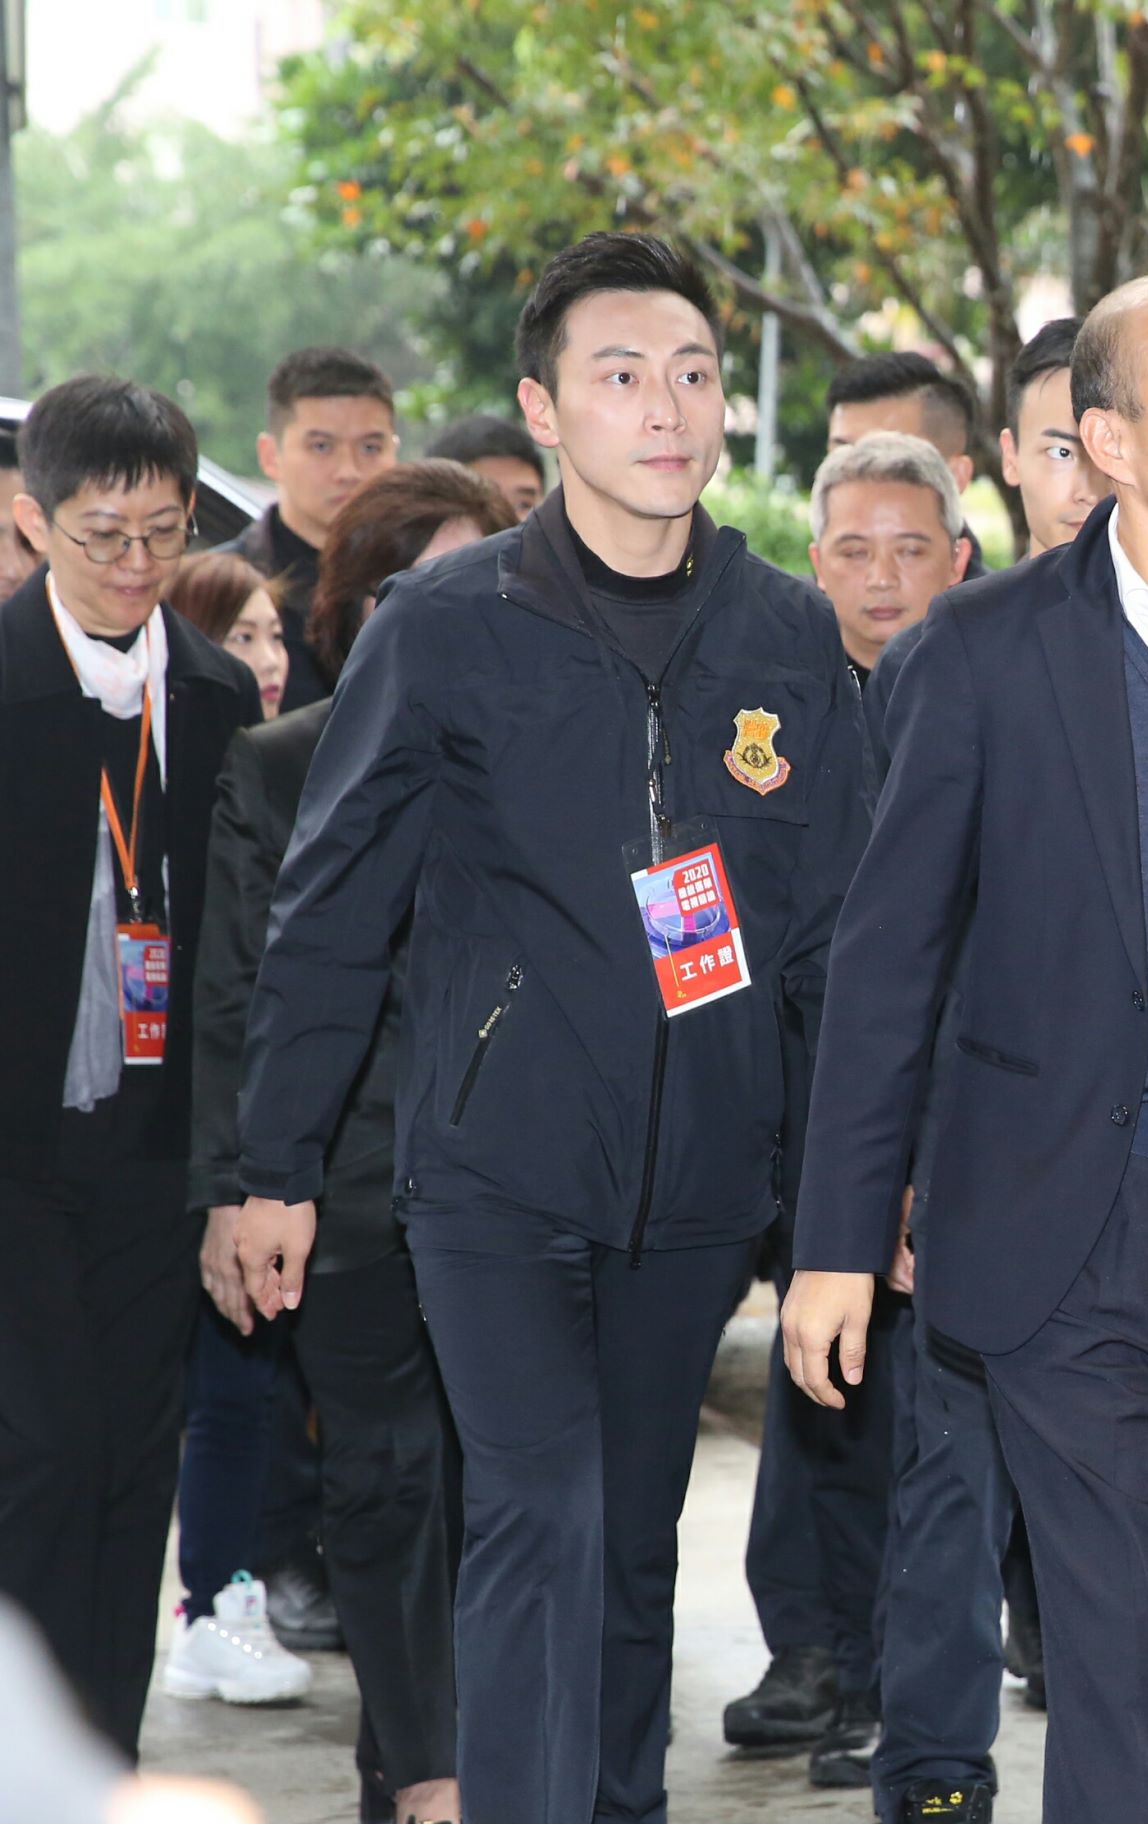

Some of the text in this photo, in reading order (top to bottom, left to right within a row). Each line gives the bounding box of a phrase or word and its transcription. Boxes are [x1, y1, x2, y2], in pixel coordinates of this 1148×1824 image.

[682, 863, 709, 884] 2020
[680, 945, 735, 982] 工作證
